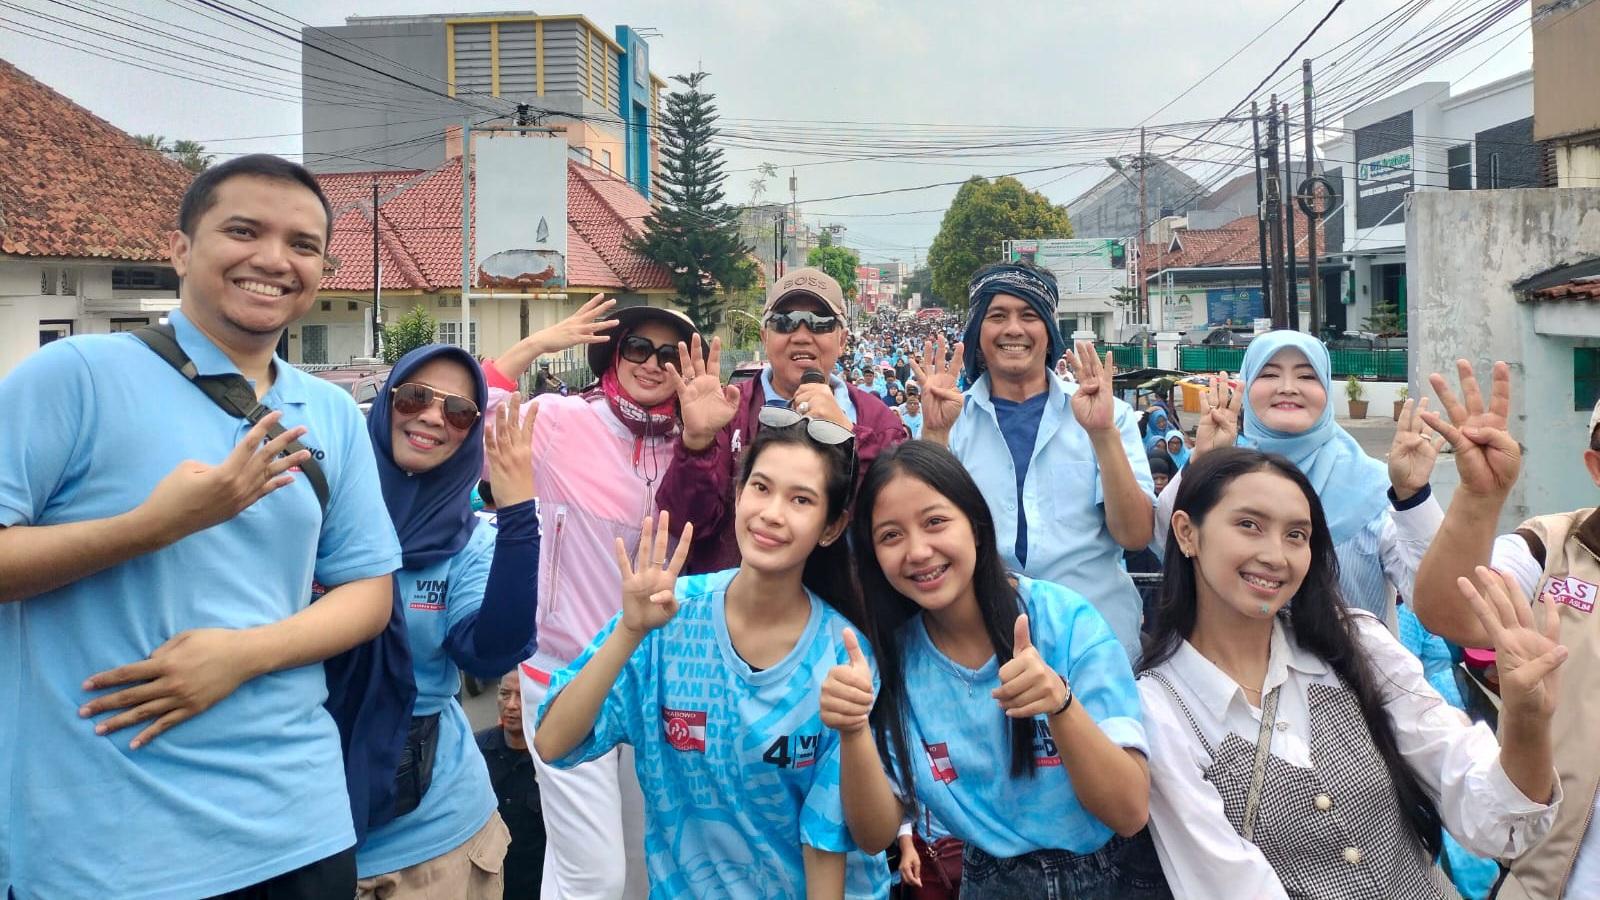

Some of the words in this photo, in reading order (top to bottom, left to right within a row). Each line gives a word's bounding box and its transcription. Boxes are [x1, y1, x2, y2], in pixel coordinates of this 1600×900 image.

[784, 276, 828, 290] BOSS
[1549, 580, 1588, 599] SAS
[763, 735, 791, 769] 4
